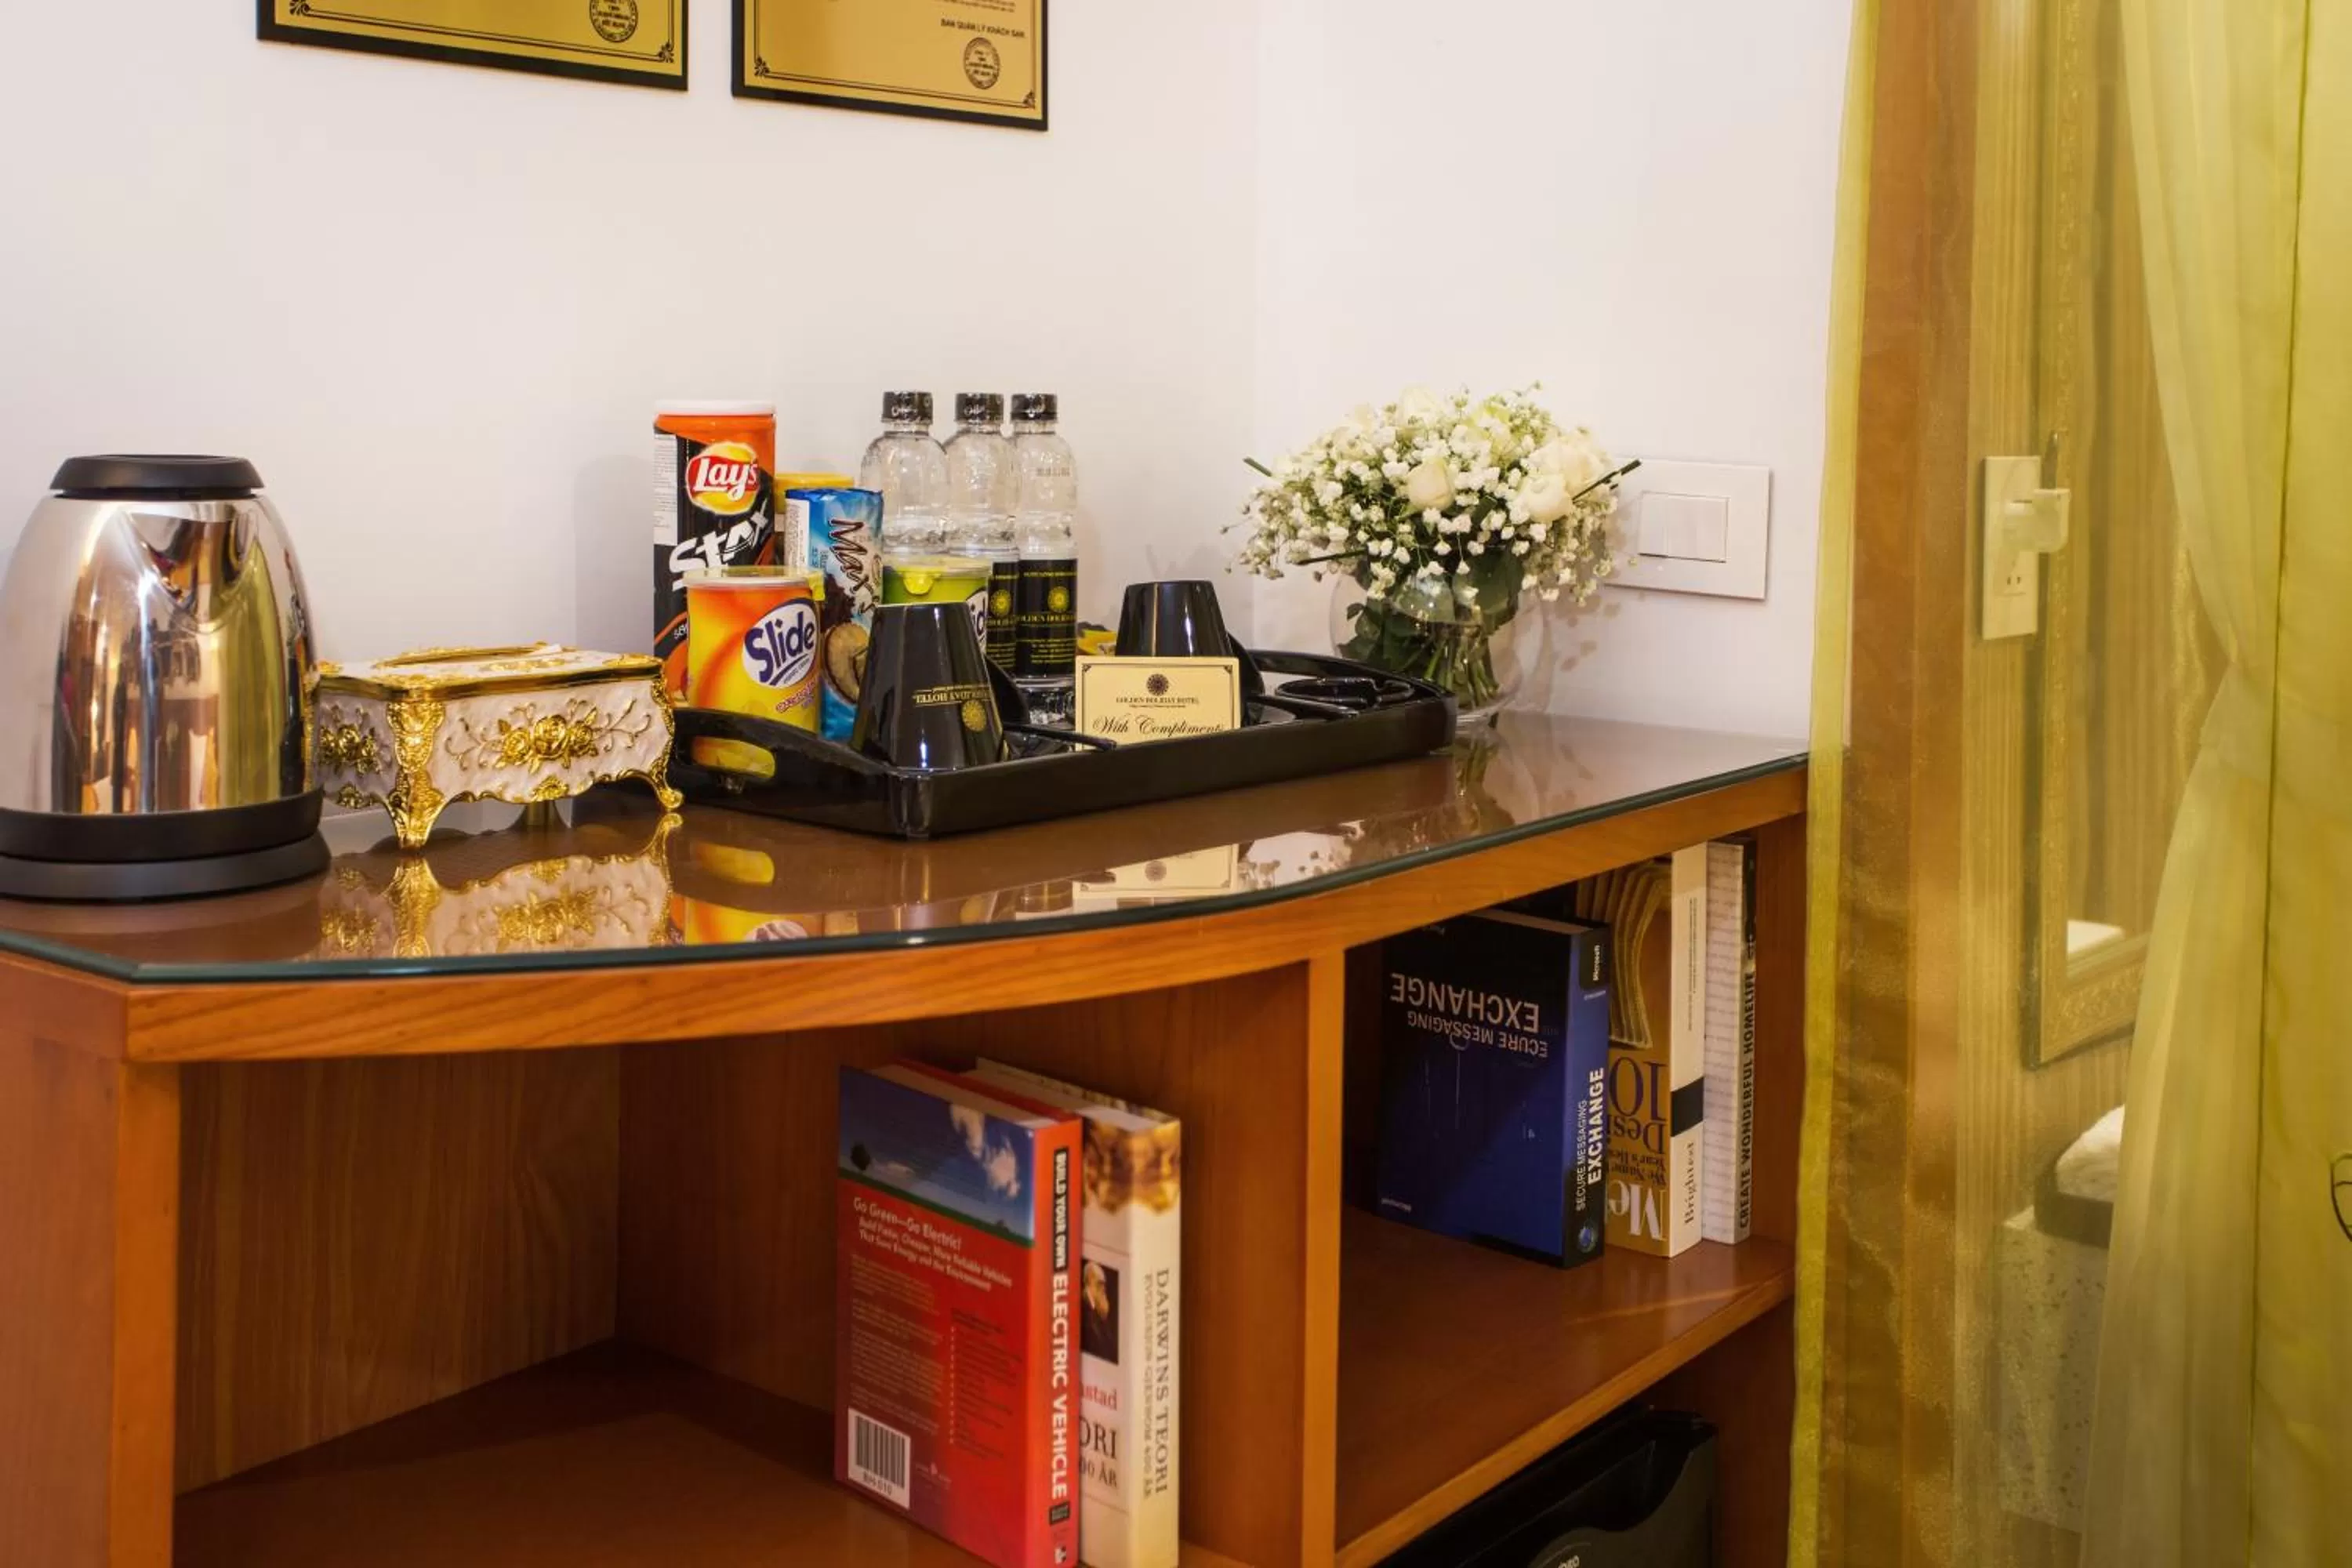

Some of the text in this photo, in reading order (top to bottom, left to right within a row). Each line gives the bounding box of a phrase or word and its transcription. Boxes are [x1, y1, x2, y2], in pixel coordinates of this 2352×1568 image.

[693, 458, 758, 501] Lay's
[745, 611, 815, 683] Slide
[1093, 713, 1131, 734] With
[1389, 972, 1540, 1033] EXCHANGE
[1406, 1009, 1494, 1045] MESSAGING
[1588, 1067, 1604, 1185] EXCHANGE
[1606, 1116, 1666, 1154] Desi
[1740, 1059, 1753, 1165] WONDERFUL
[1055, 1152, 1066, 1194] BUILD
[1575, 1099, 1588, 1211] SECURE MESSAGING
[853, 1196, 867, 1214] Go
[1055, 1196, 1066, 1233] YOUR
[1608, 1180, 1668, 1241] Me
[1740, 1168, 1751, 1229] CREATE
[1055, 1235, 1066, 1268] OWN
[1053, 1273, 1069, 1388] ELECTRIC
[1155, 1268, 1169, 1494] DARWINS TEORI
[1051, 1394, 1068, 1500] VEHICLE
[1080, 1416, 1117, 1460] ORI
